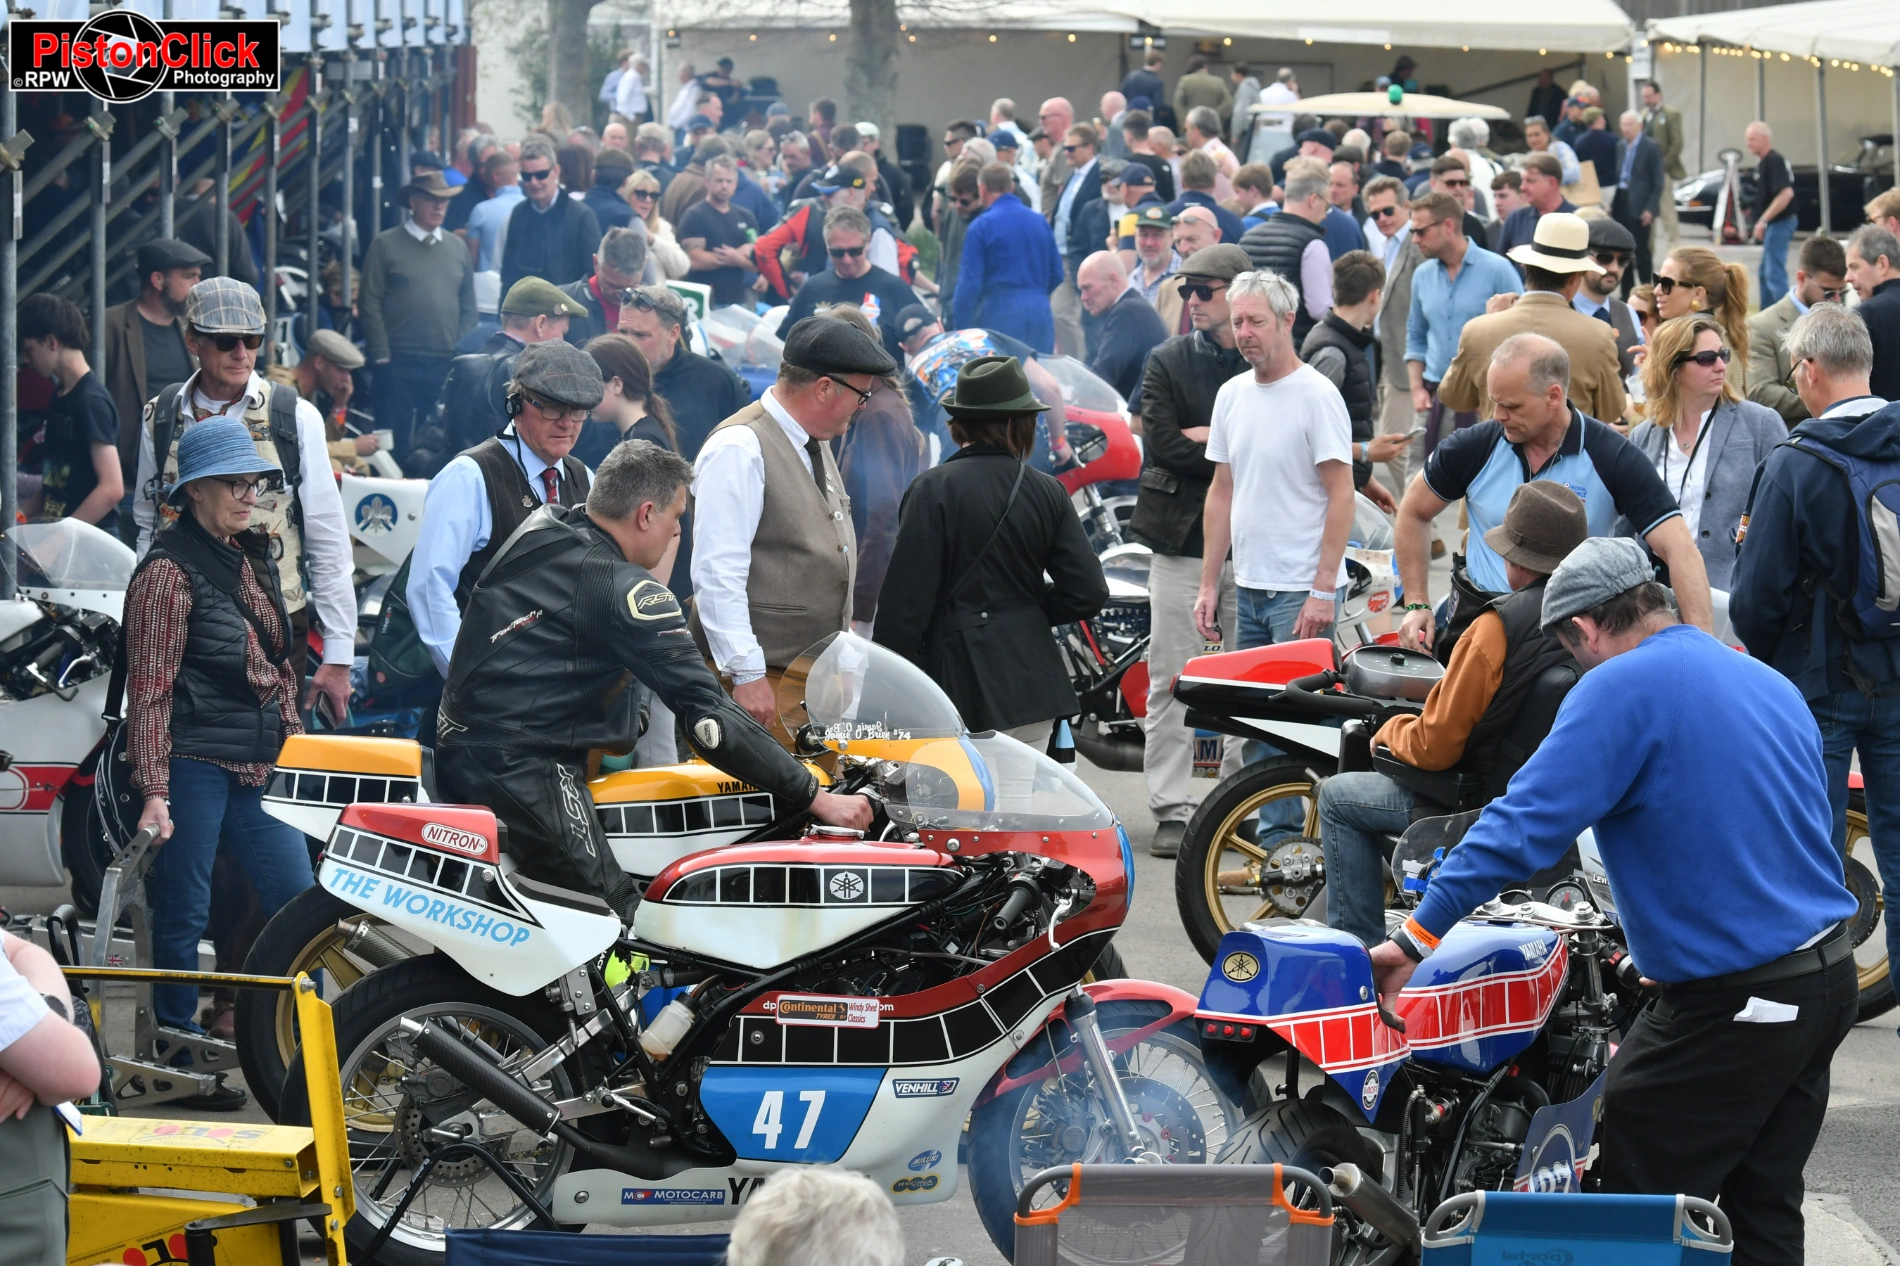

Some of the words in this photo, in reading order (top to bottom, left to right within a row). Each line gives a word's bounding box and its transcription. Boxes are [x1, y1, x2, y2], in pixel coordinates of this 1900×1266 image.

[637, 593, 675, 610] RST
[427, 826, 481, 851] NITRON
[329, 868, 380, 899] THE
[381, 882, 530, 947] WORKSHOP
[1518, 939, 1548, 961] YAMAHA
[780, 1001, 837, 1014] Continental
[865, 1003, 878, 1012] Shed
[848, 1013, 866, 1023] Classics
[896, 1083, 939, 1094] VENHILL
[752, 1090, 826, 1149] 47
[654, 1190, 723, 1200] MOTOCARB
